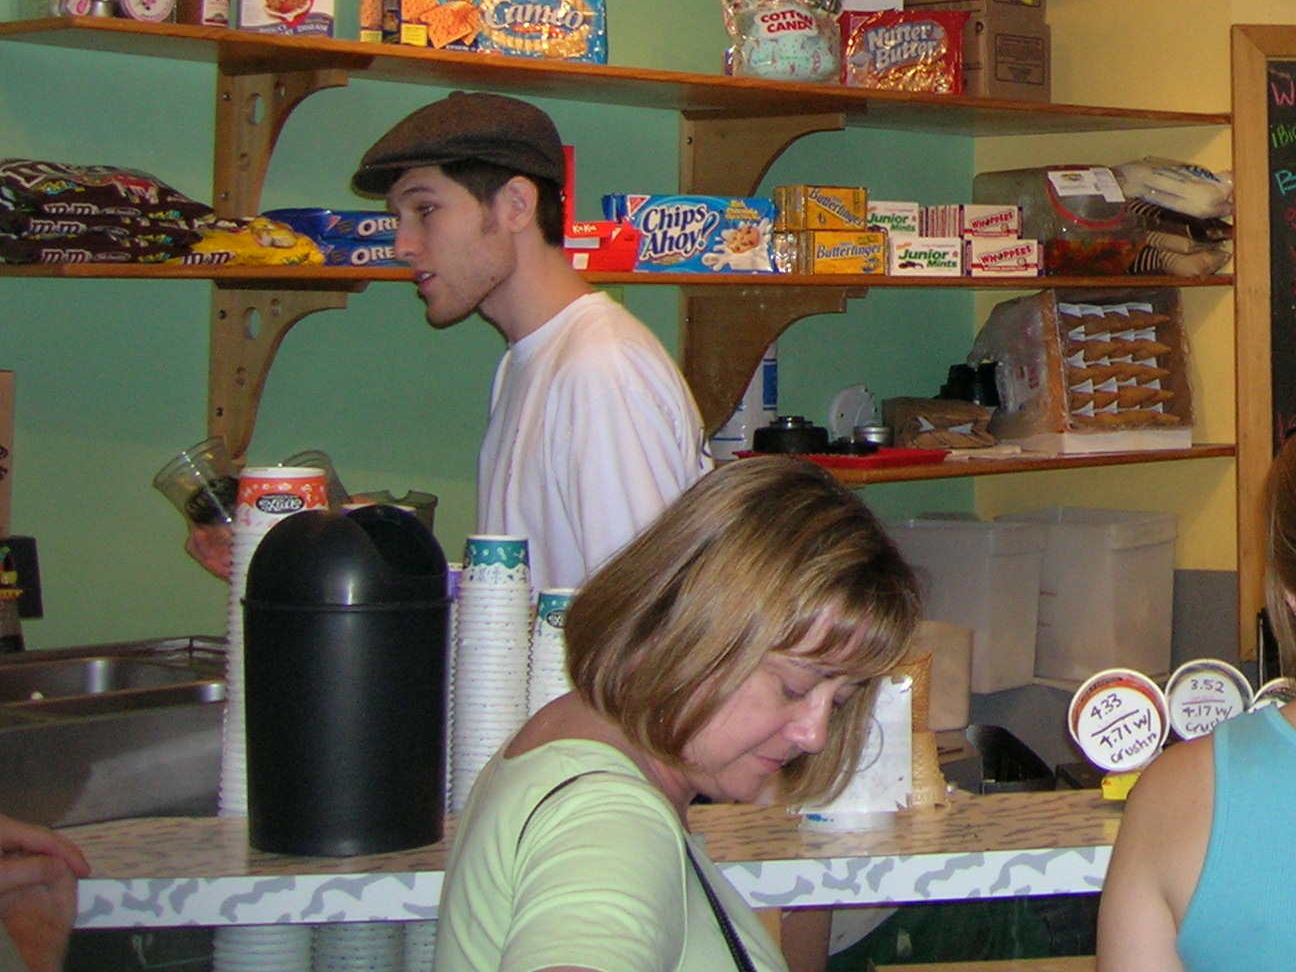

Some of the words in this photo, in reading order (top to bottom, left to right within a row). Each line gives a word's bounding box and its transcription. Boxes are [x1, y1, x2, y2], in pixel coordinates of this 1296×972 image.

[867, 22, 933, 51] Nutter
[874, 39, 939, 72] Butter
[808, 187, 864, 227] Butterfinger
[358, 215, 399, 239] ORE
[643, 205, 707, 233] Chips
[868, 212, 909, 224] Junior
[890, 223, 916, 233] Mints
[971, 211, 1013, 229] WHOPPERS
[641, 213, 719, 260] Ahoy!
[351, 246, 395, 266] ORE
[815, 241, 884, 261] Butterfinger
[898, 248, 949, 260] Junior
[980, 244, 1032, 264] WHOPPERS
[926, 259, 957, 268] Mints
[1190, 679, 1225, 695] 3.52
[1182, 705, 1212, 718] 4.17
[1099, 723, 1133, 750] 4.71
